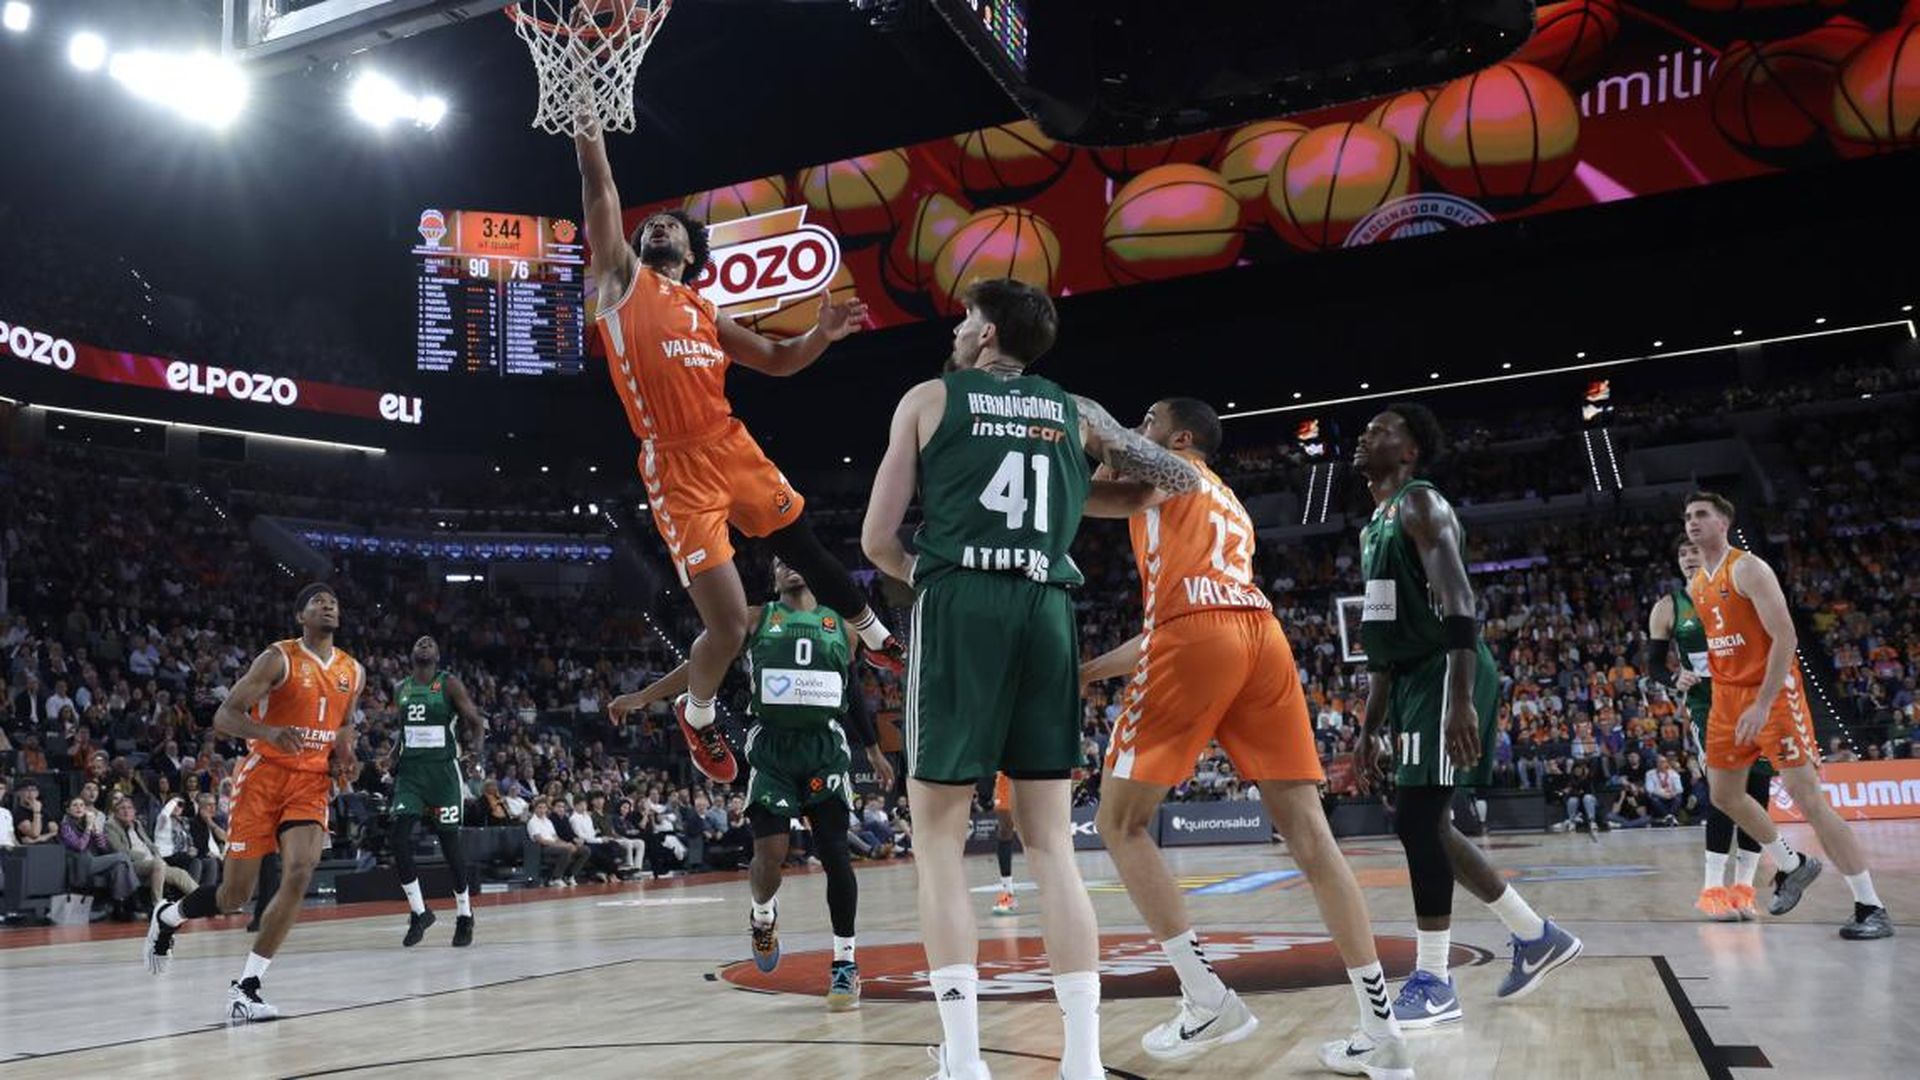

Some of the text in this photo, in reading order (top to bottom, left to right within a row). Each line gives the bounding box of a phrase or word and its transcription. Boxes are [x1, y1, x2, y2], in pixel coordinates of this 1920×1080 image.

[483, 217, 521, 240] 3:44
[469, 258, 489, 278] 90
[509, 260, 529, 279] 76
[683, 305, 698, 332] 7
[967, 392, 1065, 424] HERNANGOMEZ
[972, 416, 1066, 443] instacar
[979, 451, 1049, 533] 41
[1209, 511, 1252, 585] 13
[1711, 606, 1724, 630] 3
[795, 638, 813, 666] 0
[319, 696, 328, 722] 1
[408, 704, 426, 721] 22
[1401, 732, 1420, 765] 11
[1781, 737, 1800, 760] 3
[440, 806, 459, 823] 22
